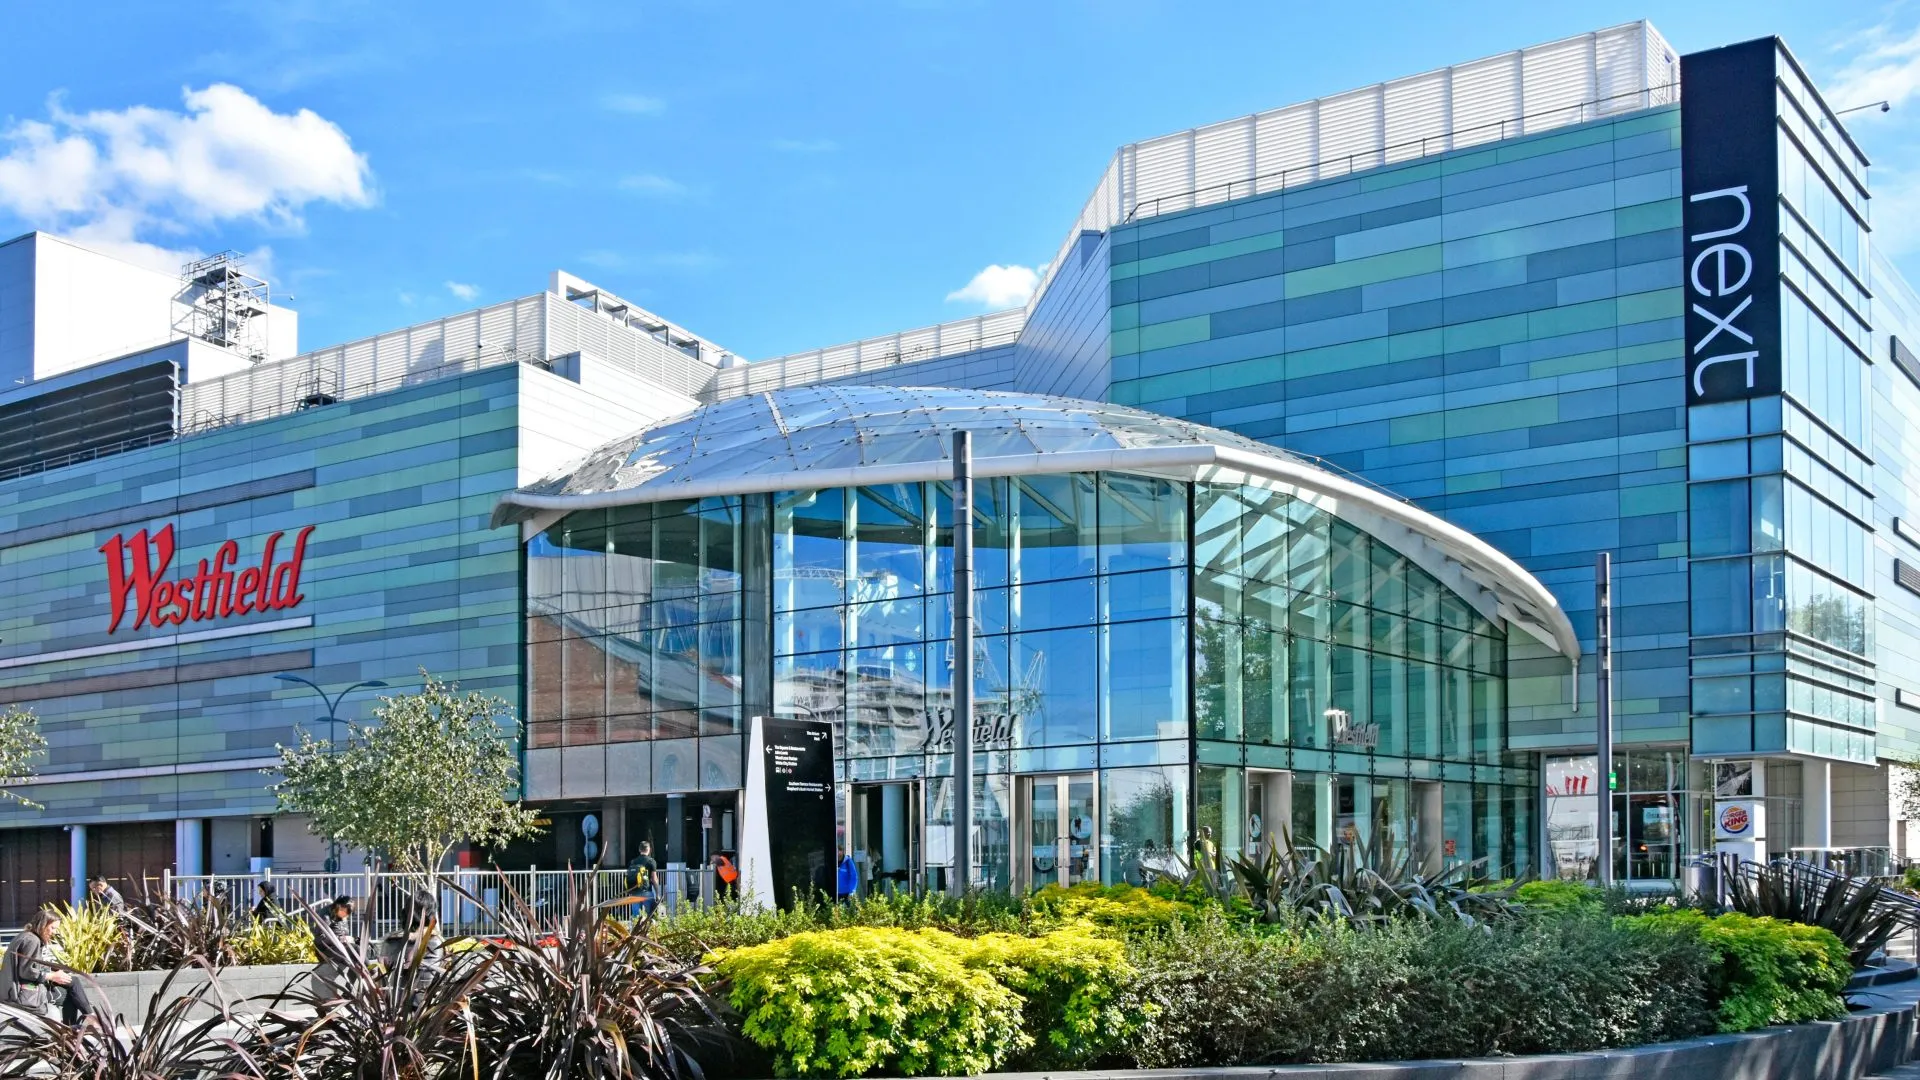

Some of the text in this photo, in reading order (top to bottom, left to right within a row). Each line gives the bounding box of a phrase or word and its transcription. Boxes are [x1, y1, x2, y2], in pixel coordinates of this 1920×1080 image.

[1690, 184, 1759, 397] next
[98, 523, 316, 635] Westfield
[1724, 815, 1748, 828] KING
